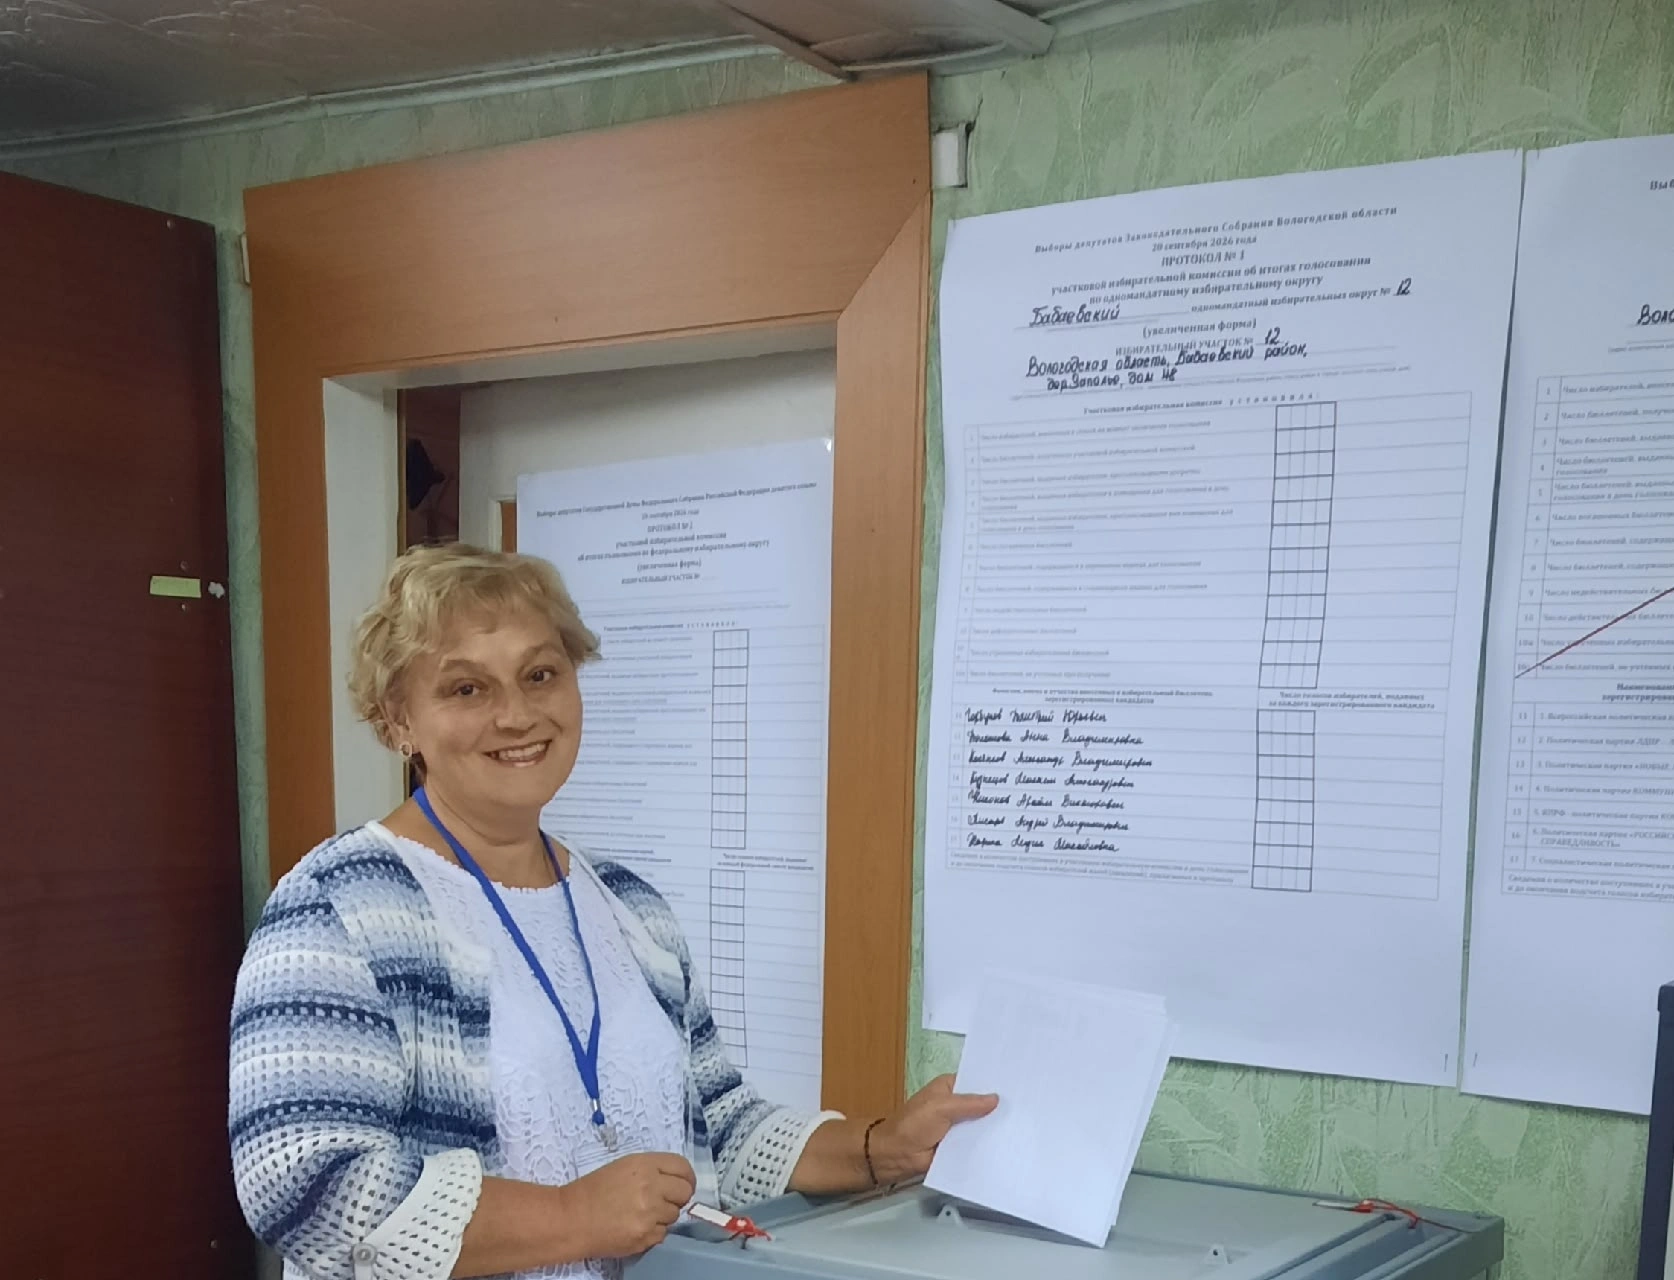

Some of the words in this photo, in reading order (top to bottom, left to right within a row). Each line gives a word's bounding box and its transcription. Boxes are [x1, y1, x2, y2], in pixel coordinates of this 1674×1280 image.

[1276, 211, 1348, 227] Вологодской
[1351, 206, 1397, 218] области
[1164, 240, 1208, 251] сентября
[1210, 235, 1234, 247] 2026
[1235, 235, 1257, 245] года
[1161, 252, 1222, 268] ПРОТОКОЛ
[1225, 250, 1237, 262] №
[1239, 249, 1245, 261] 1
[1051, 280, 1107, 296] участковой
[1108, 272, 1186, 291] избирательной
[1188, 266, 1241, 281] комиссии
[1244, 265, 1257, 277] об
[1259, 263, 1296, 276] итогах
[1299, 256, 1371, 272] голосования
[1089, 295, 1103, 306] по
[1104, 285, 1189, 305] одномандатному
[1191, 279, 1282, 297] избирательному
[1285, 275, 1324, 289] округу
[1348, 289, 1377, 301] округ
[1393, 278, 1412, 297] 12
[1029, 302, 1120, 328] Бабаевский
[1143, 322, 1216, 338] (увеличенная
[1217, 318, 1257, 331] форма)
[1264, 327, 1281, 346] 12
[1115, 339, 1197, 356] ИЗБИРАТЕЛЬНЫЙ
[1199, 337, 1241, 349] УЧАСТОК
[1025, 355, 1109, 378] Вологодская
